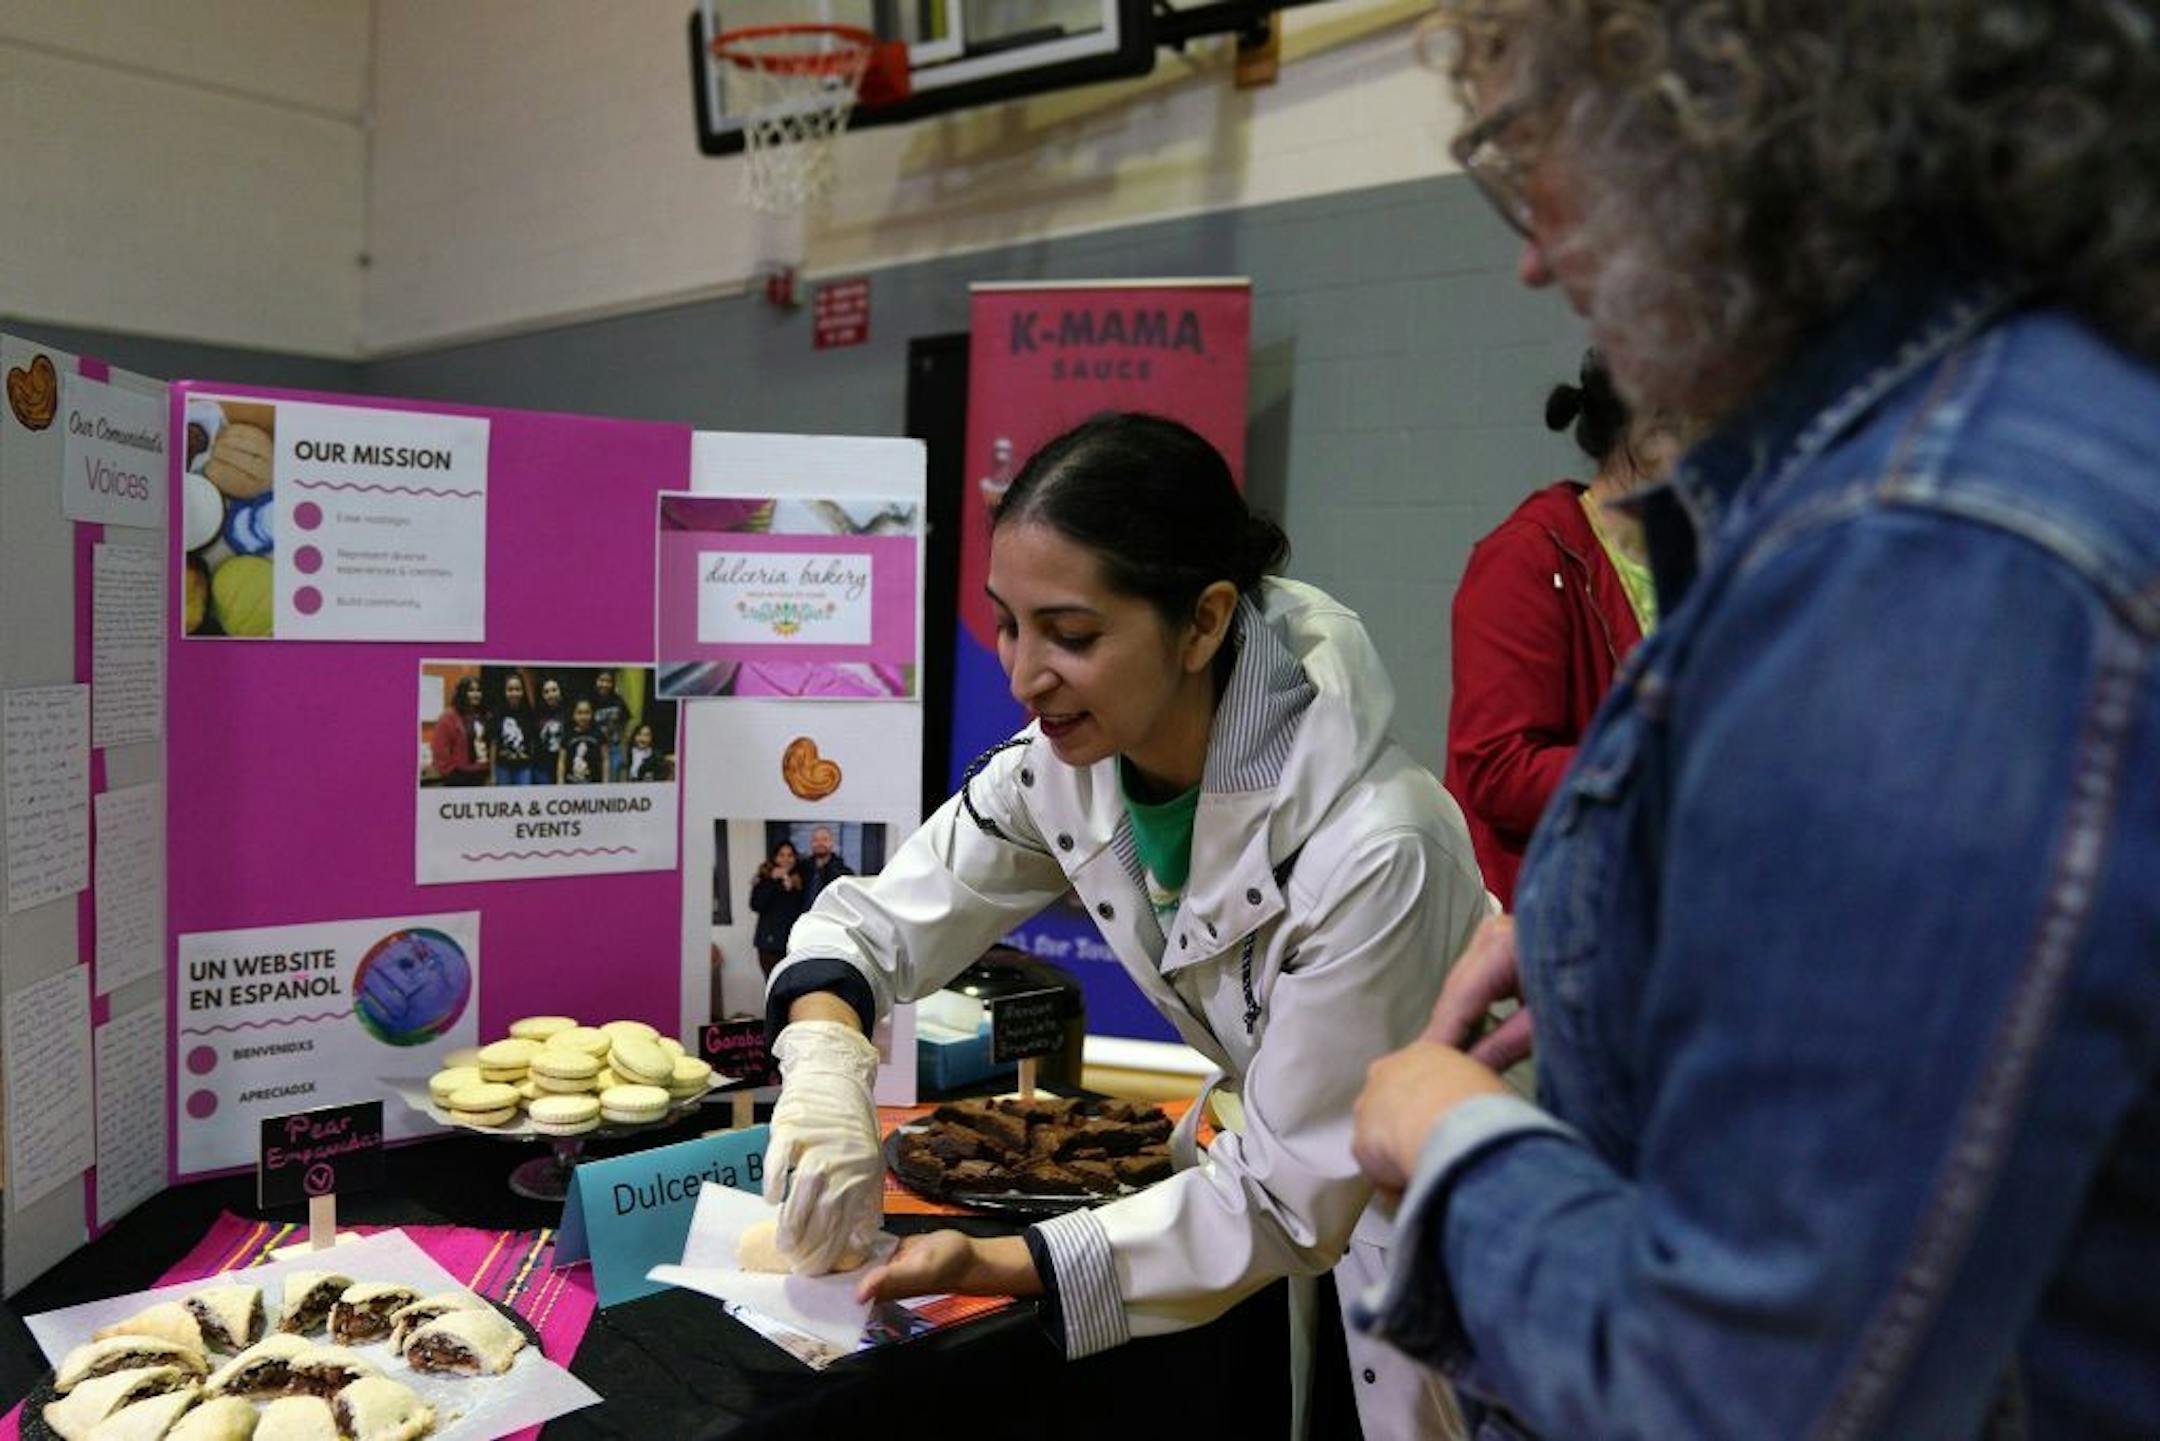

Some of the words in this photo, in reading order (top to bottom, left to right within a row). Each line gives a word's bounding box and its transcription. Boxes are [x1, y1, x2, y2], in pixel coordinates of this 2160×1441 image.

[1010, 308, 1205, 354] K-MAMA
[1052, 358, 1154, 380] SAUCE
[69, 410, 94, 437] Our
[295, 441, 347, 463] OUR
[353, 445, 452, 470] MISSION
[85, 455, 149, 500] Voices
[704, 557, 789, 585] dulceria
[800, 558, 868, 600] bakery
[439, 802, 523, 819] CULTURA
[528, 801, 541, 816] &
[546, 797, 652, 815] COMUNIDAD
[515, 821, 581, 839] EVENTS
[190, 960, 226, 981] UN
[234, 949, 336, 976] WEBSITE
[190, 988, 222, 1010] EN
[230, 972, 342, 1006] ESPAÑOL
[285, 1115, 351, 1142] Pear
[614, 1160, 737, 1215] Dulceria
